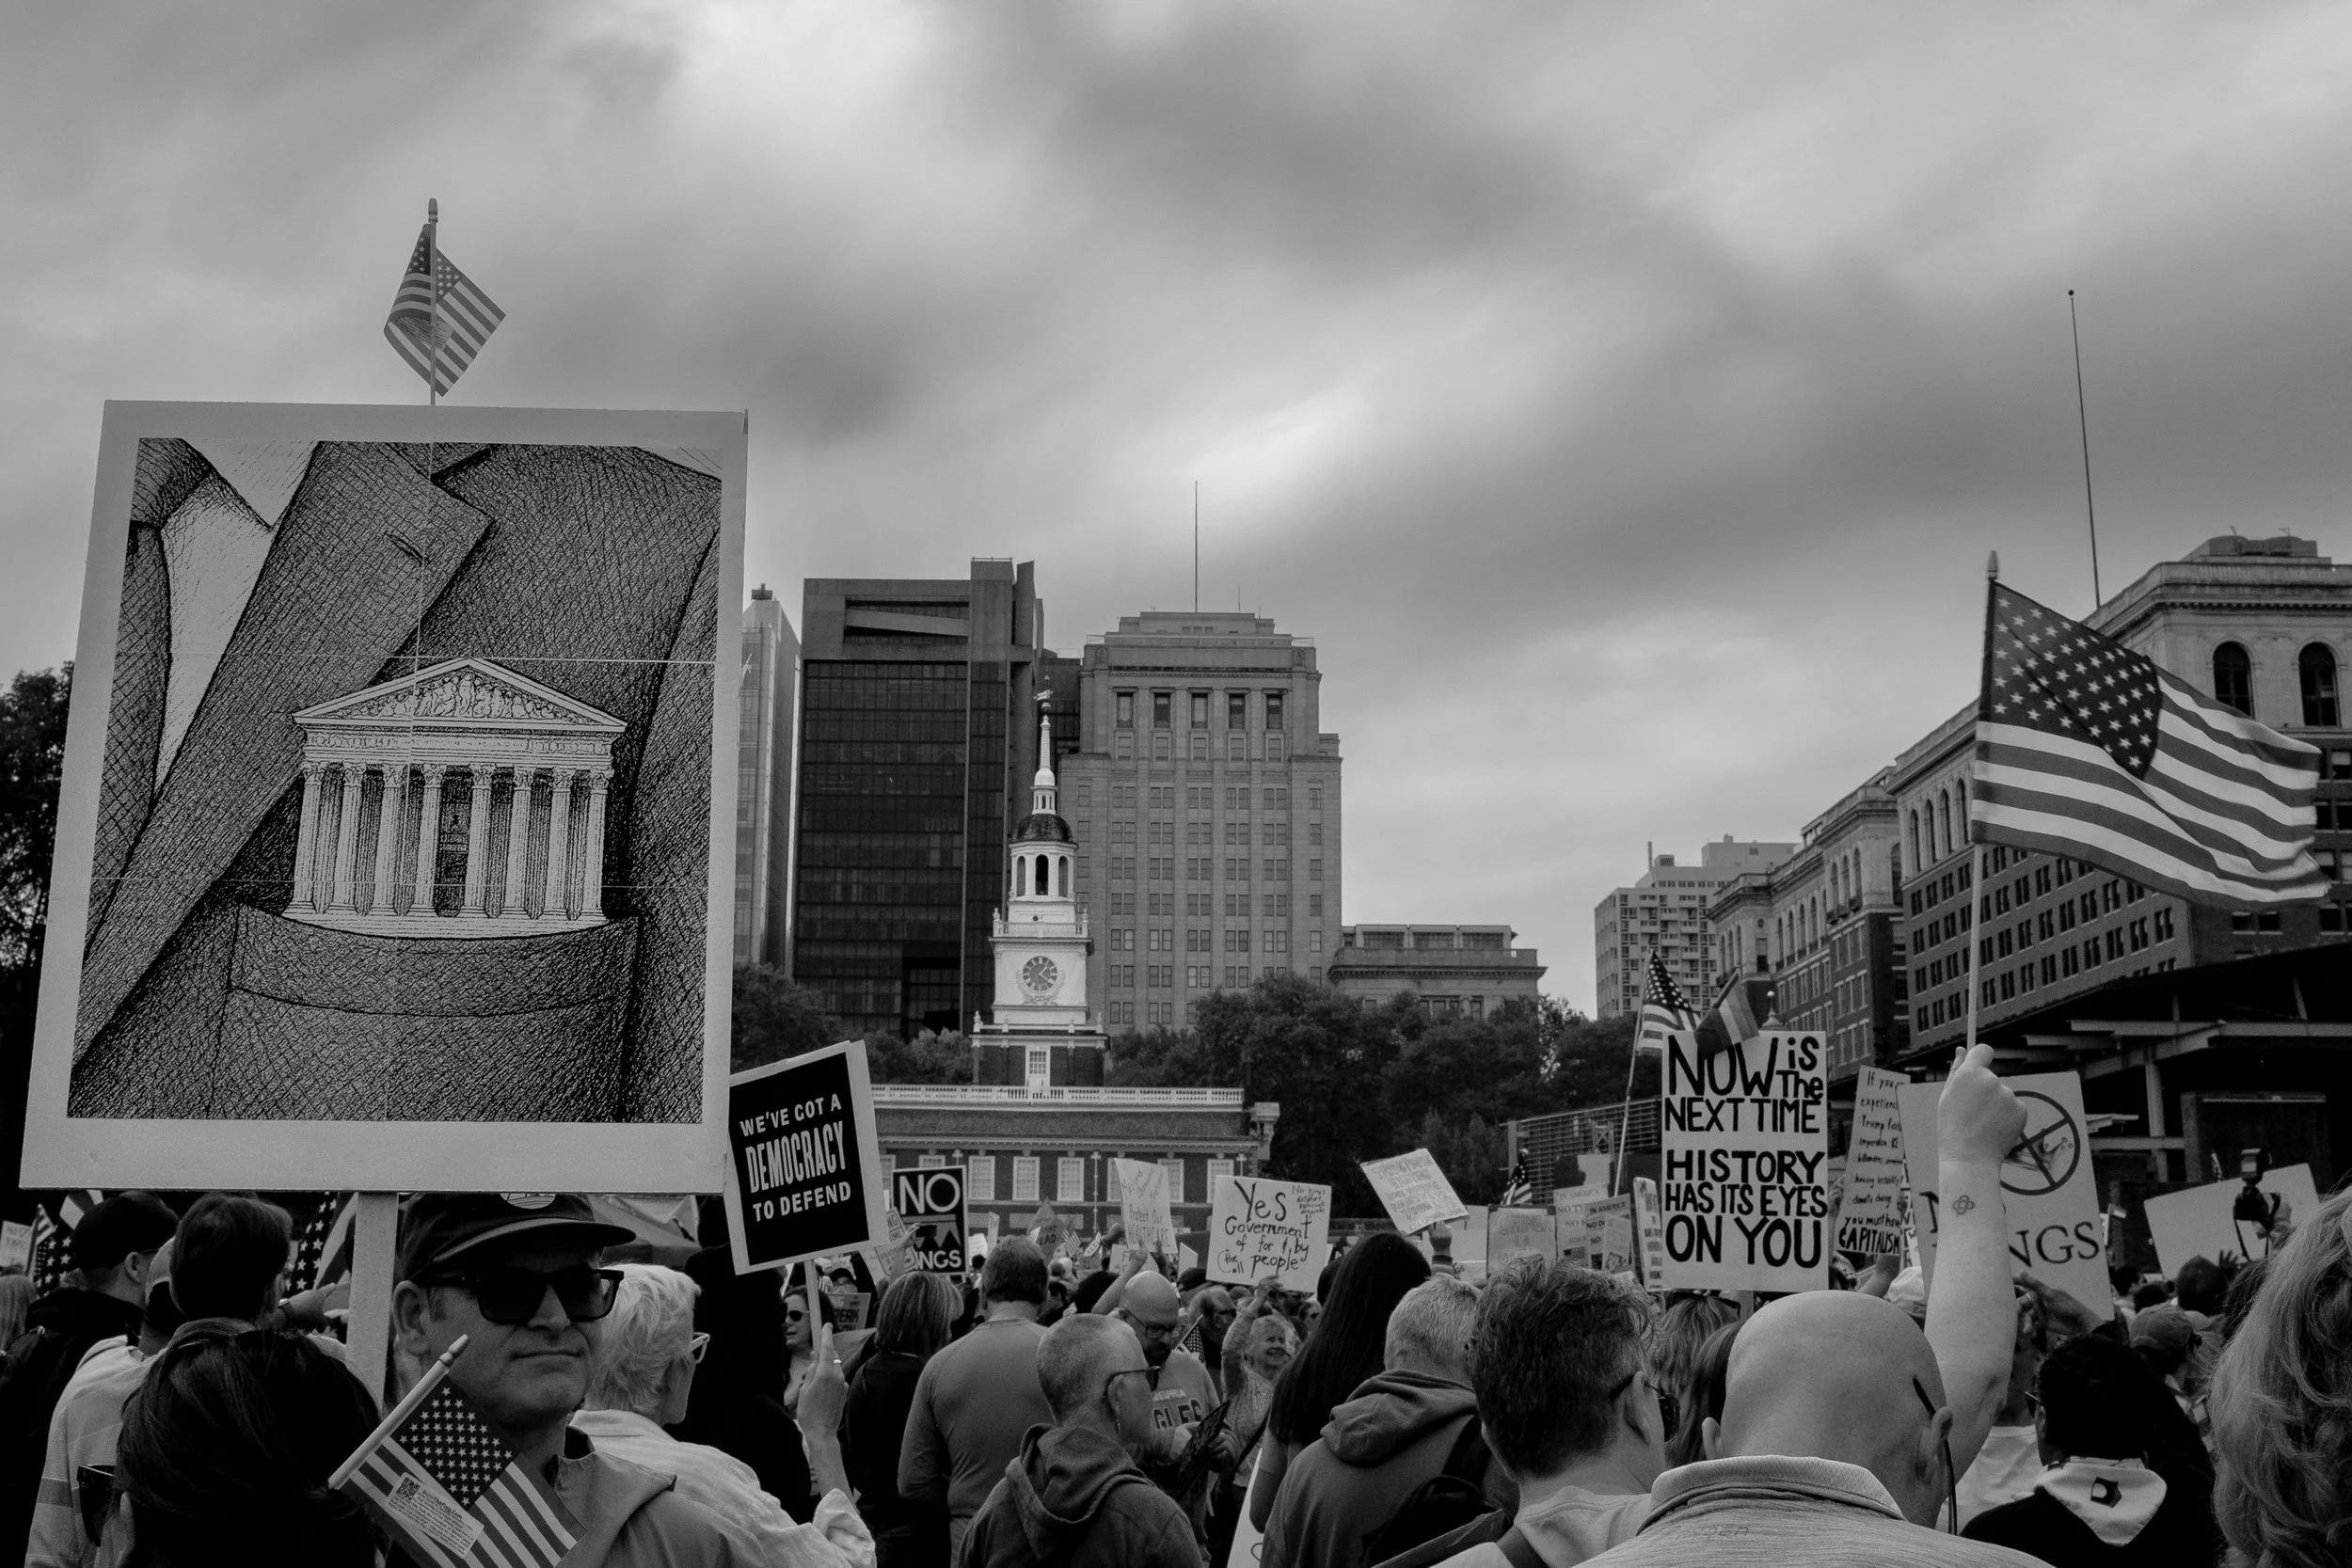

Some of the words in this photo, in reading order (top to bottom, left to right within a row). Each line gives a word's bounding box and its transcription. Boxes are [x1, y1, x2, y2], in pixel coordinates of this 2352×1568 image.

[1667, 1034, 1779, 1097] NOW
[1788, 1036, 1820, 1072] is
[1879, 1078, 1894, 1090] you
[1776, 1069, 1823, 1101] The
[739, 1108, 789, 1136] WE'VE
[794, 1098, 825, 1121] GOT
[831, 1093, 842, 1112] A
[1665, 1097, 1745, 1132] NEXT
[1750, 1098, 1821, 1133] TIME
[745, 1120, 846, 1194] DEMOCRACY
[1666, 1148, 1826, 1185] HISTORY
[753, 1199, 774, 1222] TO
[780, 1181, 851, 1216] DEFEND
[898, 1173, 961, 1215] NO
[1234, 1180, 1288, 1223] Yes
[1665, 1181, 1714, 1214] HAS
[1721, 1183, 1754, 1215] ITS
[1760, 1184, 1829, 1218] EYES
[1845, 1216, 1864, 1228] you
[1866, 1213, 1884, 1227] must
[1236, 1234, 1248, 1251] of
[1258, 1234, 1274, 1253] for
[1665, 1214, 1723, 1263] ON
[1734, 1216, 1822, 1269] YOU
[1838, 1226, 1899, 1254] CAPITALISM
[2009, 1221, 2100, 1268] NGS
[1251, 1249, 1298, 1278] people
